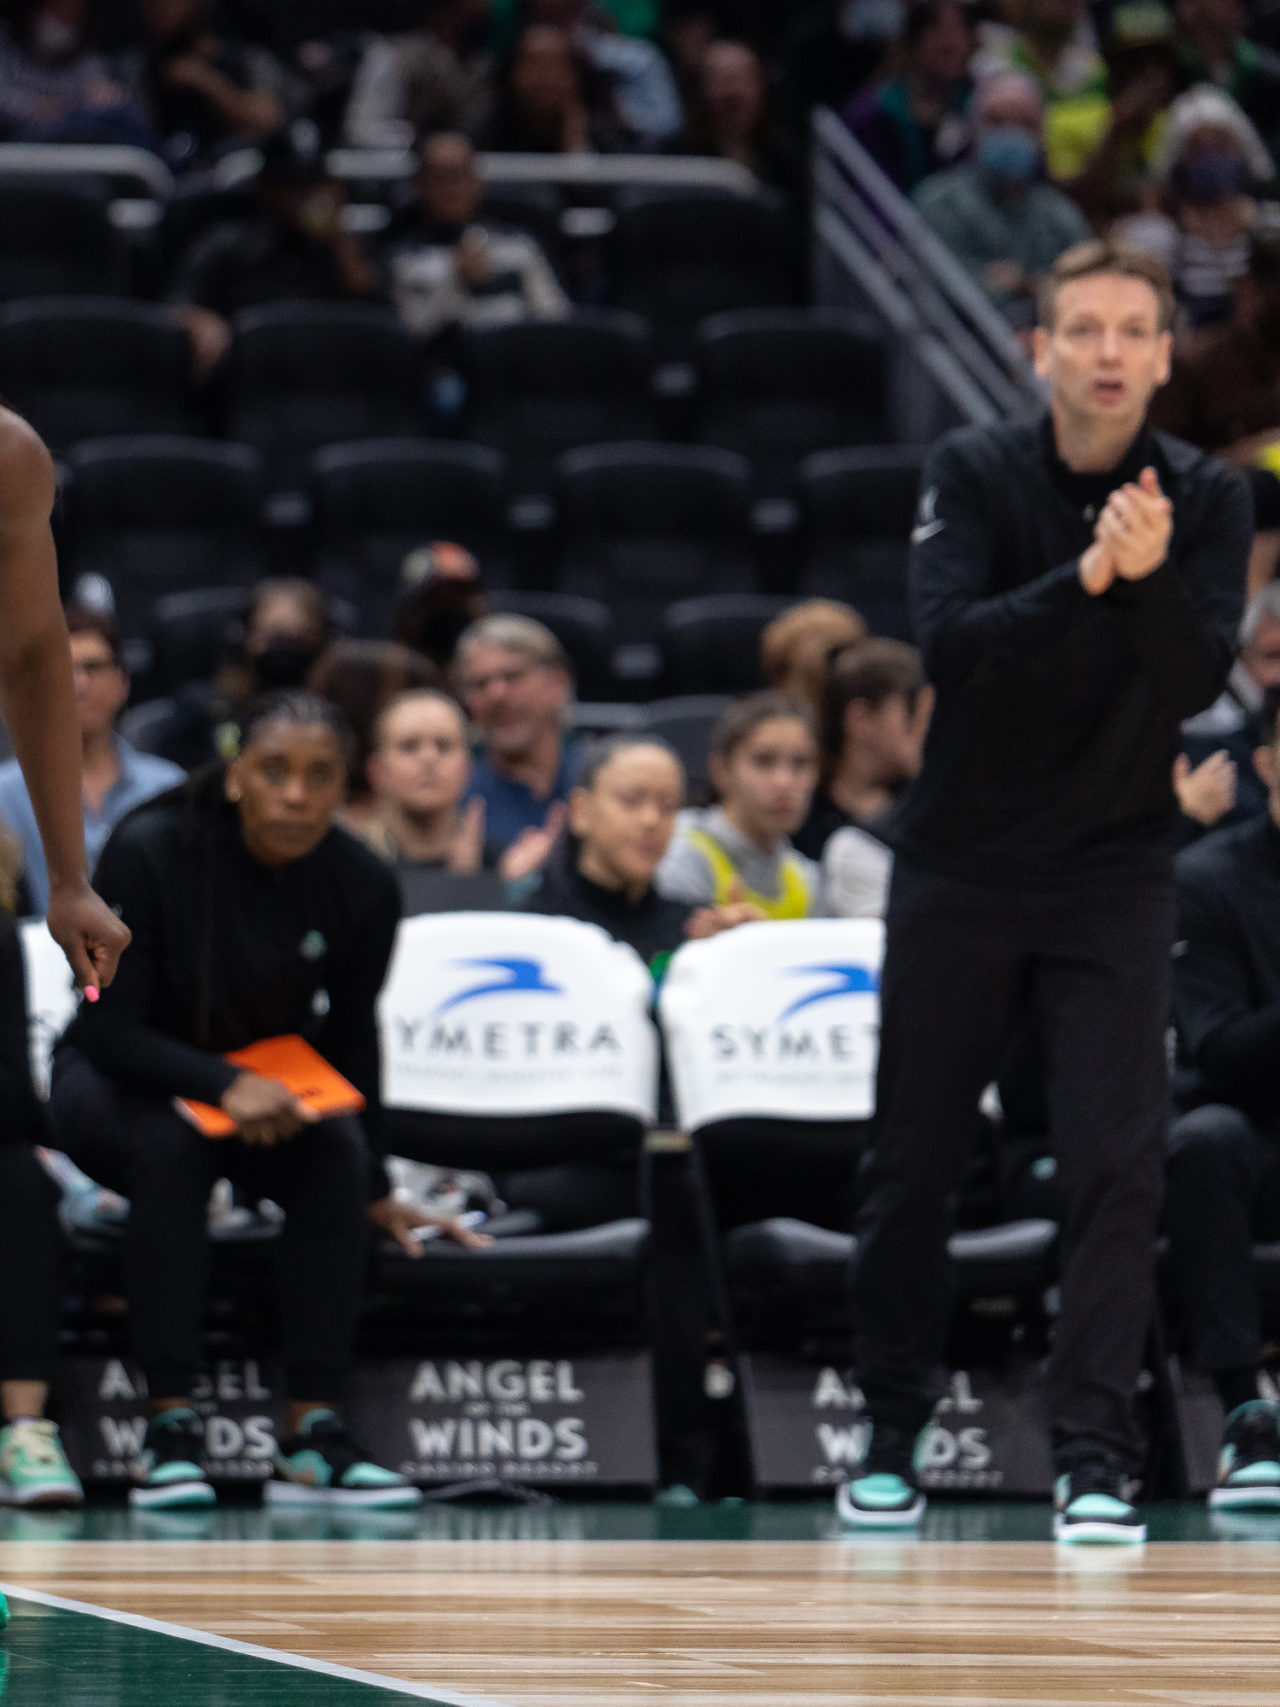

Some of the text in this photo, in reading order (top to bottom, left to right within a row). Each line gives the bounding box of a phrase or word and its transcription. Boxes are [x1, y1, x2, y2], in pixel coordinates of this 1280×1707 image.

[408, 1359, 586, 1402] ANGEL
[99, 1415, 279, 1459] WDS
[408, 1417, 589, 1460] WINDS
